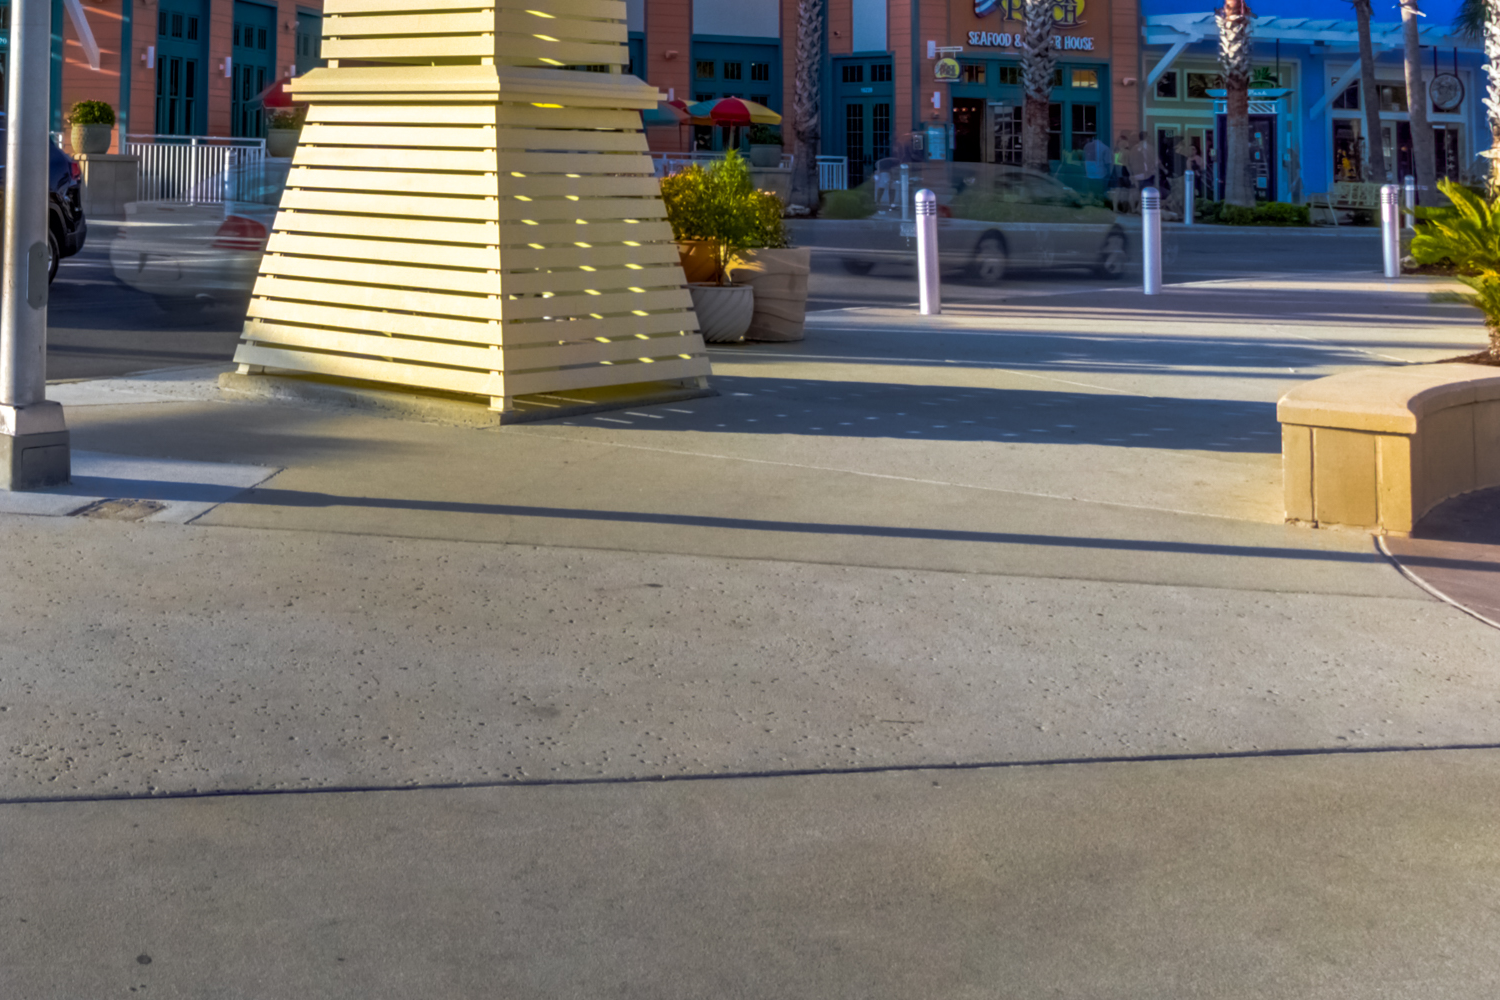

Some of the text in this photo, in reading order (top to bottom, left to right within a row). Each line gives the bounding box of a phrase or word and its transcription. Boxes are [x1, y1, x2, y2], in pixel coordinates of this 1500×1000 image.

[969, 31, 1012, 47] SEAFOOD
[1014, 33, 1023, 48] &
[1064, 36, 1095, 50] HOUSE
